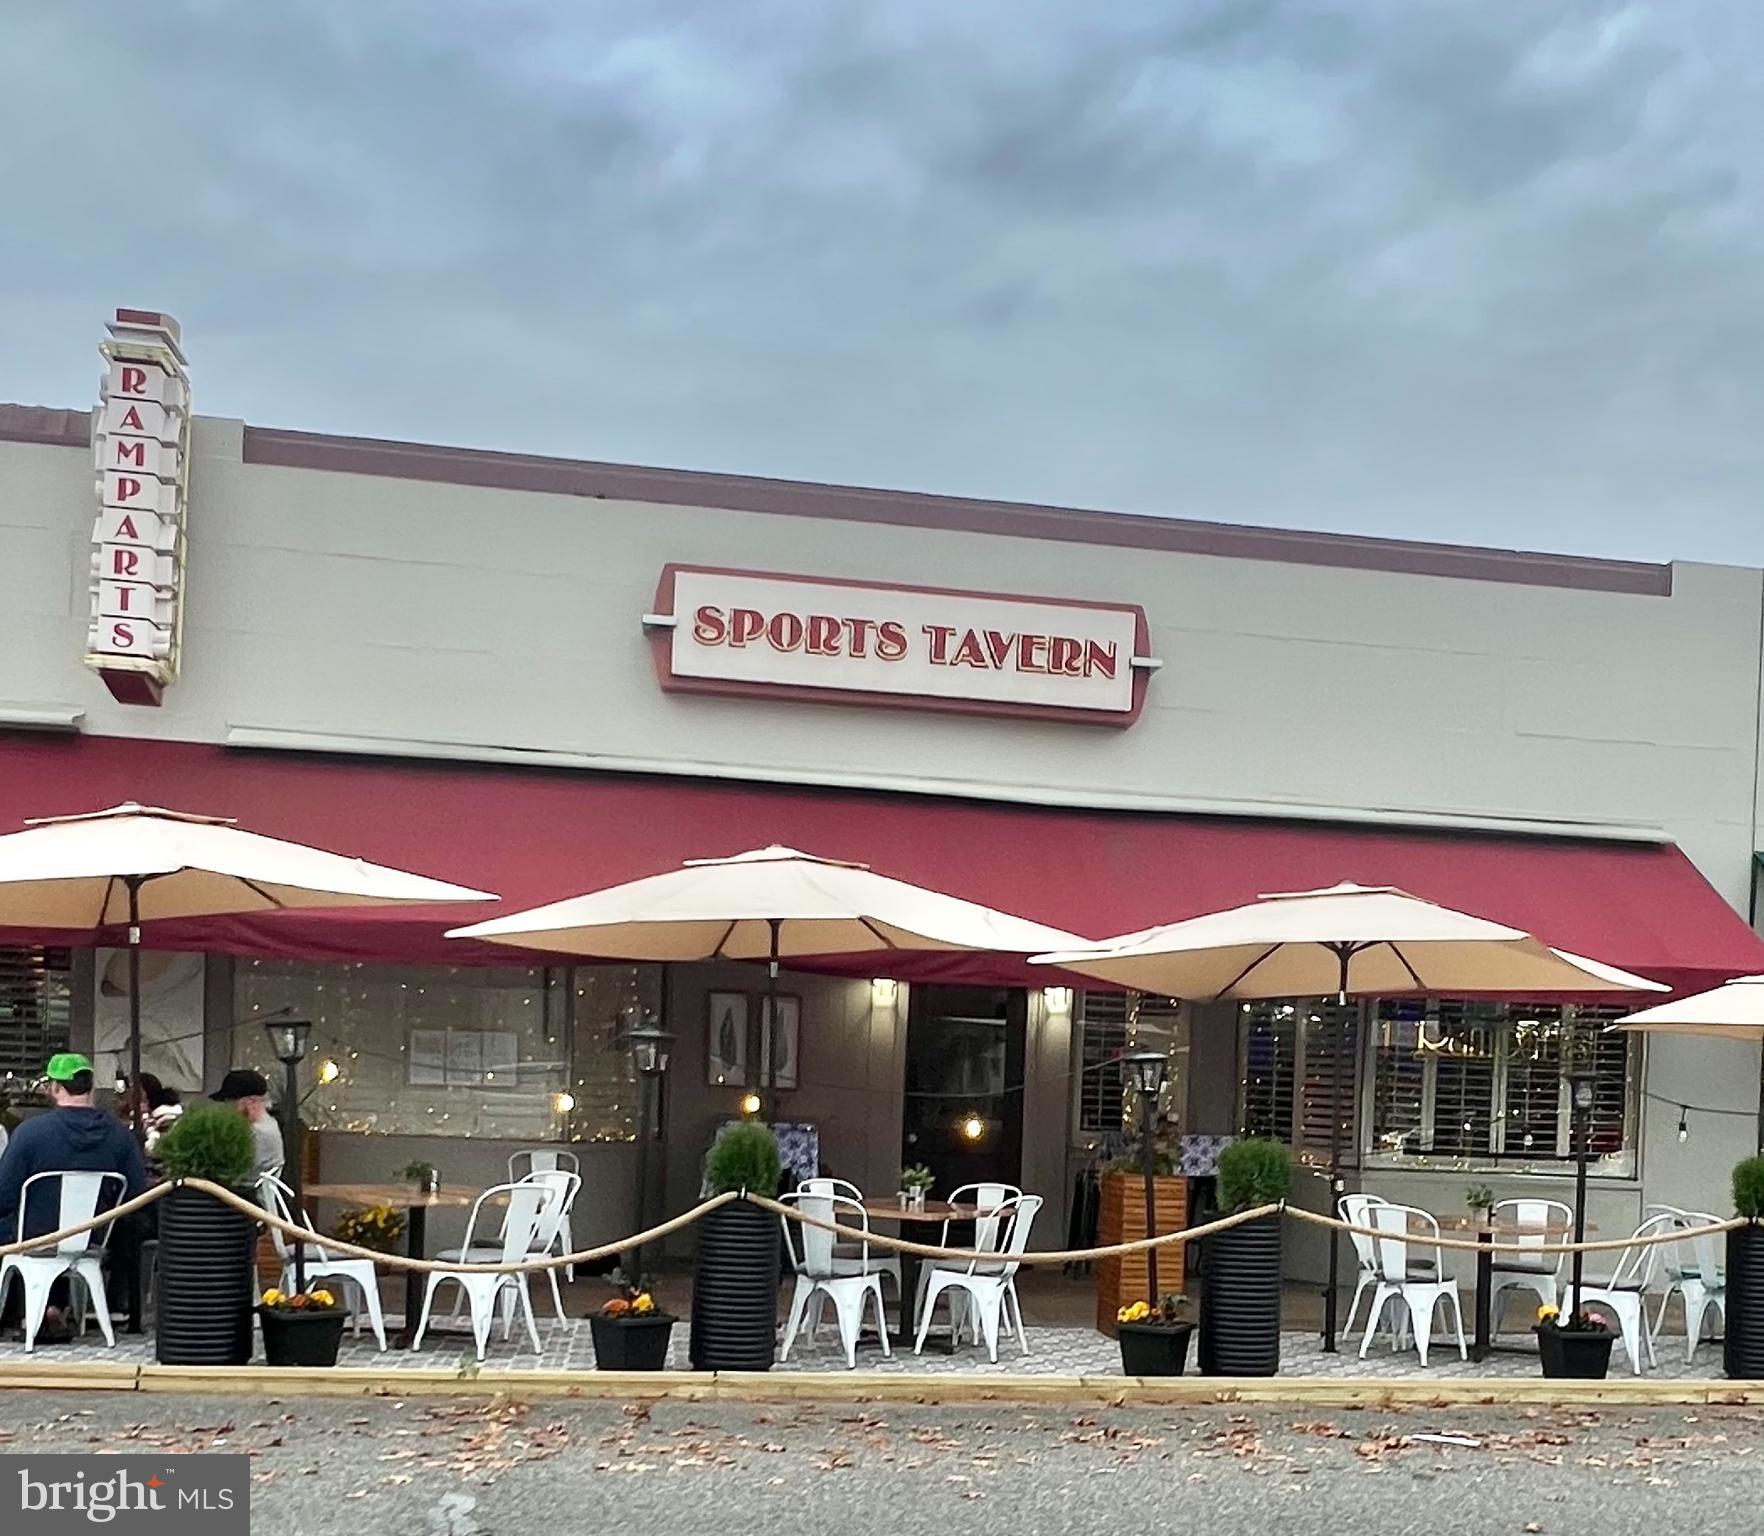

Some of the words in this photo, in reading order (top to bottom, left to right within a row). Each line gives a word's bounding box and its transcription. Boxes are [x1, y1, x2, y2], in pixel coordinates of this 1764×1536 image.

[112, 367, 146, 648] RAMPARTS
[693, 604, 909, 662] SPORTS
[921, 622, 1117, 680] TAVERN
